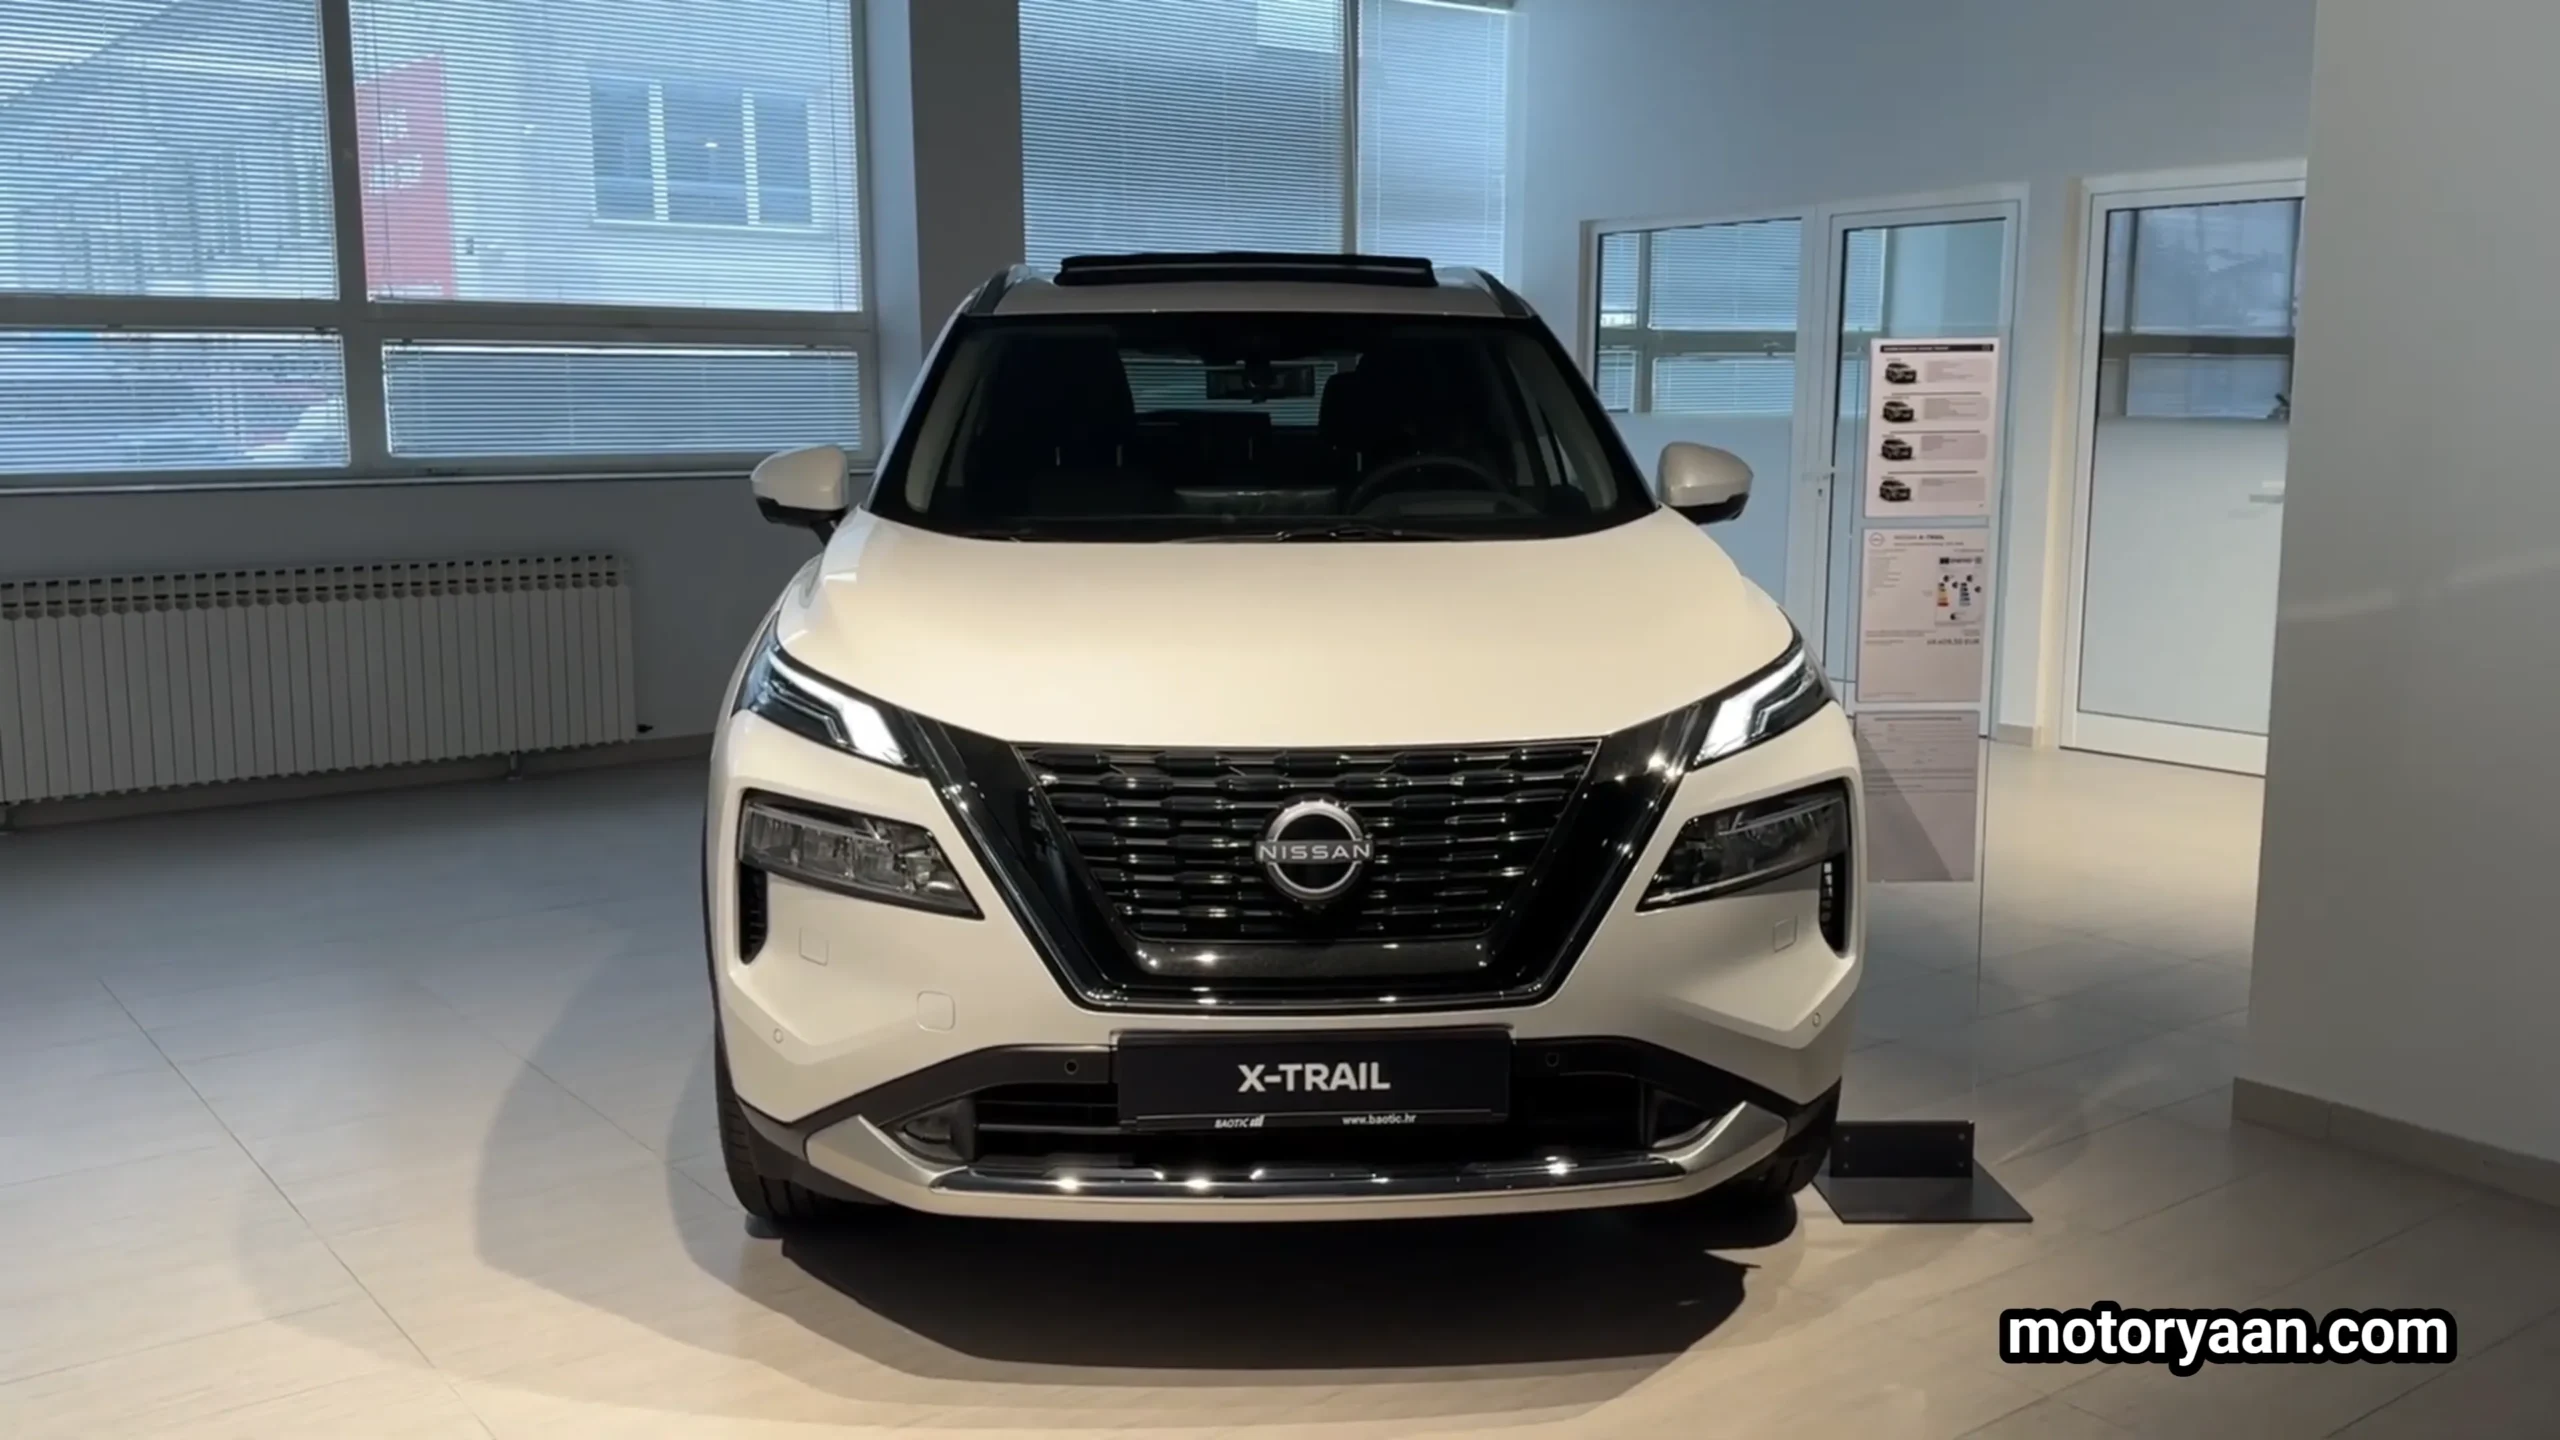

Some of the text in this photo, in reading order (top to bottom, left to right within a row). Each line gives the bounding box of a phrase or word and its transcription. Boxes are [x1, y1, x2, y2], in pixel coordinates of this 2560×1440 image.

[1259, 844, 1370, 860] NISSAN
[1238, 1062, 1391, 1093] X-TRAIL
[1213, 1118, 1249, 1129] BAOTIC
[1342, 1113, 1417, 1126] www.baotic.hr
